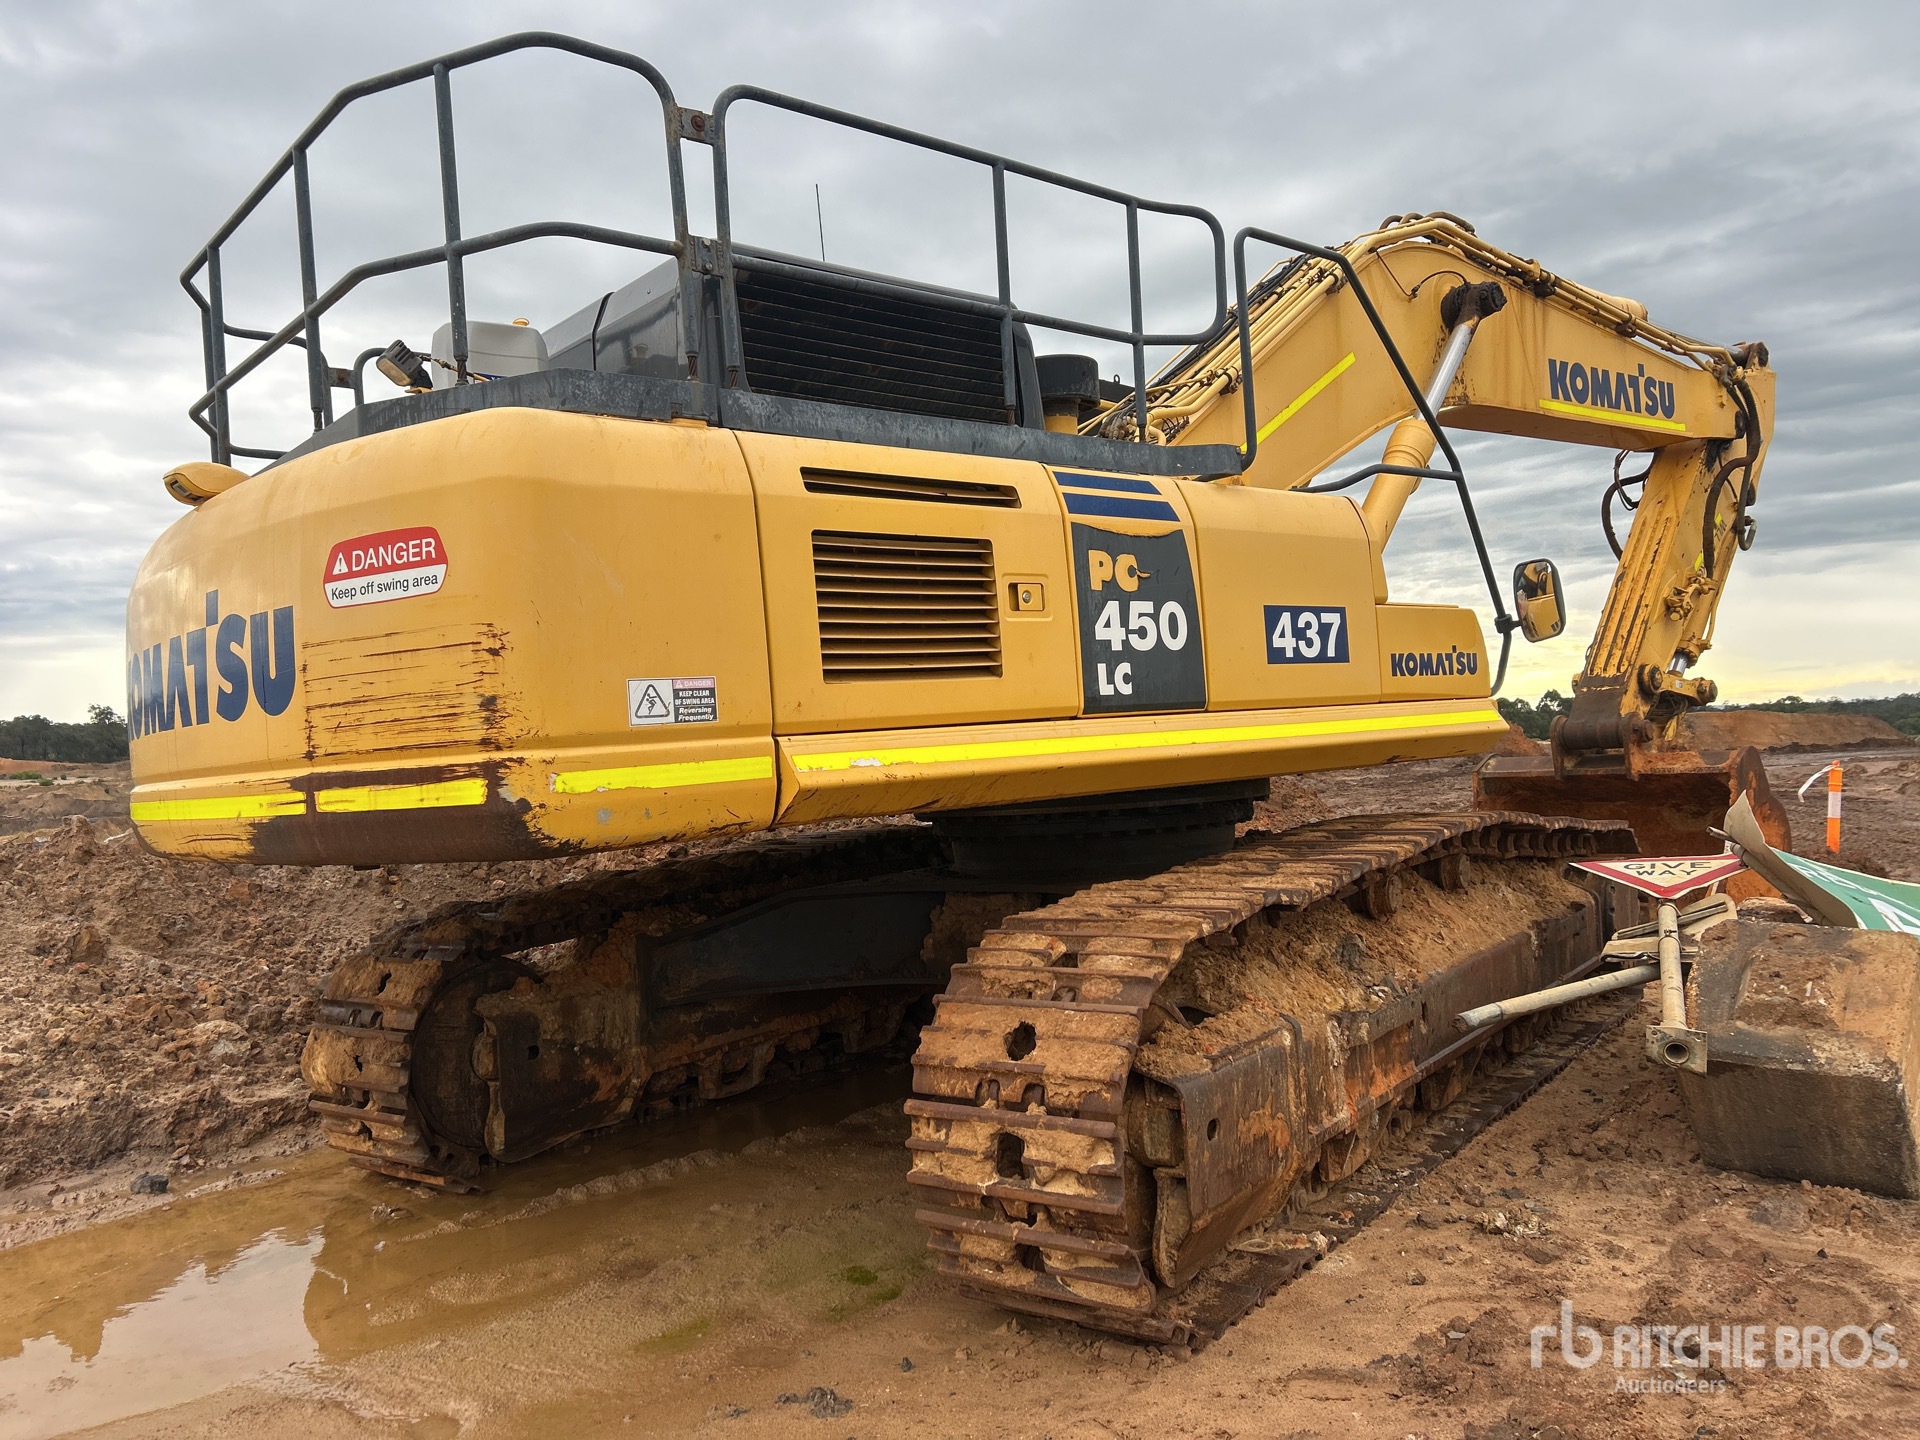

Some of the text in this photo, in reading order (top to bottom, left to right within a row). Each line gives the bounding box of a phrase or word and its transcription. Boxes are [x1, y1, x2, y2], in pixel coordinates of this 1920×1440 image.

[1548, 358, 1675, 419] KOMATSU
[351, 537, 436, 572] DANGER
[1088, 549, 1141, 593] PC
[331, 573, 439, 600] Keep off swing area
[1094, 600, 1188, 651] 450
[1271, 611, 1342, 659] 437
[128, 589, 296, 742] OMATSU
[1390, 644, 1479, 678] KOMATSU
[684, 680, 712, 688] DANGER
[1096, 662, 1133, 696] LC
[678, 706, 713, 714] Reversing
[678, 713, 714, 722] Frequently
[682, 697, 701, 705] SWING
[1623, 861, 1712, 870] GIVE
